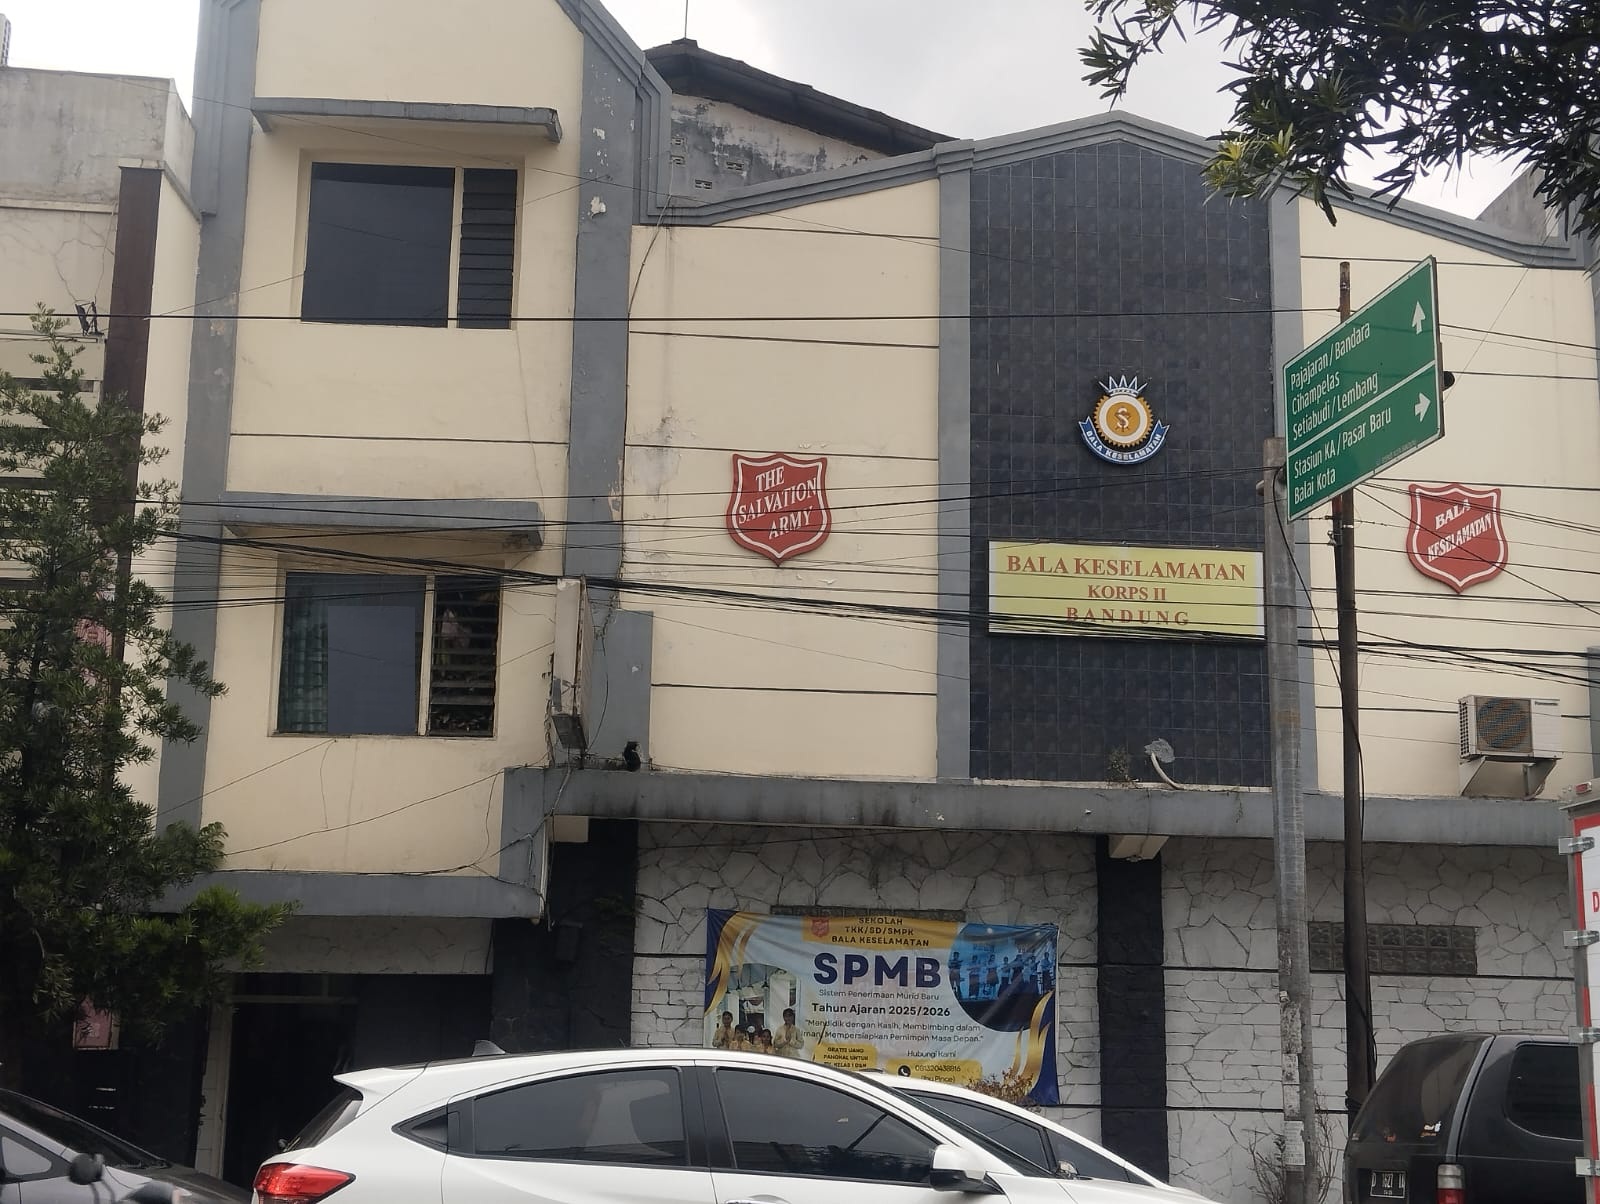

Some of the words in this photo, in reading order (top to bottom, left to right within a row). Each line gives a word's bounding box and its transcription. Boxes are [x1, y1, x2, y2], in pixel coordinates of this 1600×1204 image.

[1291, 353, 1328, 391] Pajajaran
[1335, 323, 1370, 360] Bandara
[1292, 371, 1340, 415] Cihampelas
[1293, 400, 1330, 440] Setiabudi
[1337, 372, 1378, 412] Lembang
[1086, 430, 1103, 452] BALA
[1105, 433, 1162, 460] KESELAMATAN
[1294, 450, 1322, 479] Stasiun
[1342, 422, 1366, 450] Pasar
[1370, 407, 1391, 433] Baru
[756, 466, 784, 491] THE
[1295, 477, 1314, 504] Balai
[1317, 468, 1335, 491] Kota
[739, 477, 816, 524] SALVATION
[1435, 498, 1471, 530] BALA
[769, 506, 813, 540] ARMY
[1428, 513, 1492, 562] KESELAMATAN
[1007, 555, 1068, 574] BALA
[1074, 557, 1246, 581] KESELAMATAN
[1088, 585, 1148, 600] KORPS
[1153, 587, 1166, 601] II
[1066, 607, 1189, 626] BANDUNG
[858, 917, 903, 925] SEKOLAH
[859, 936, 930, 946] KESELAMATAN
[813, 952, 941, 988] SPMB
[819, 989, 846, 997] Sistem
[848, 990, 894, 999] Penerimaan
[897, 991, 919, 1000] Murid
[921, 993, 939, 1001] Baru
[812, 1003, 847, 1013] Tahun
[849, 1004, 886, 1015] Ajaran
[889, 1005, 950, 1017] 2025/2026
[825, 1031, 889, 1040] Mempersiapkan
[846, 1020, 876, 1029] dengan
[878, 1021, 901, 1030] Kasih,
[903, 1022, 954, 1032] Membimbing
[956, 1023, 981, 1031] dalam
[907, 1050, 937, 1058] Hubungi
